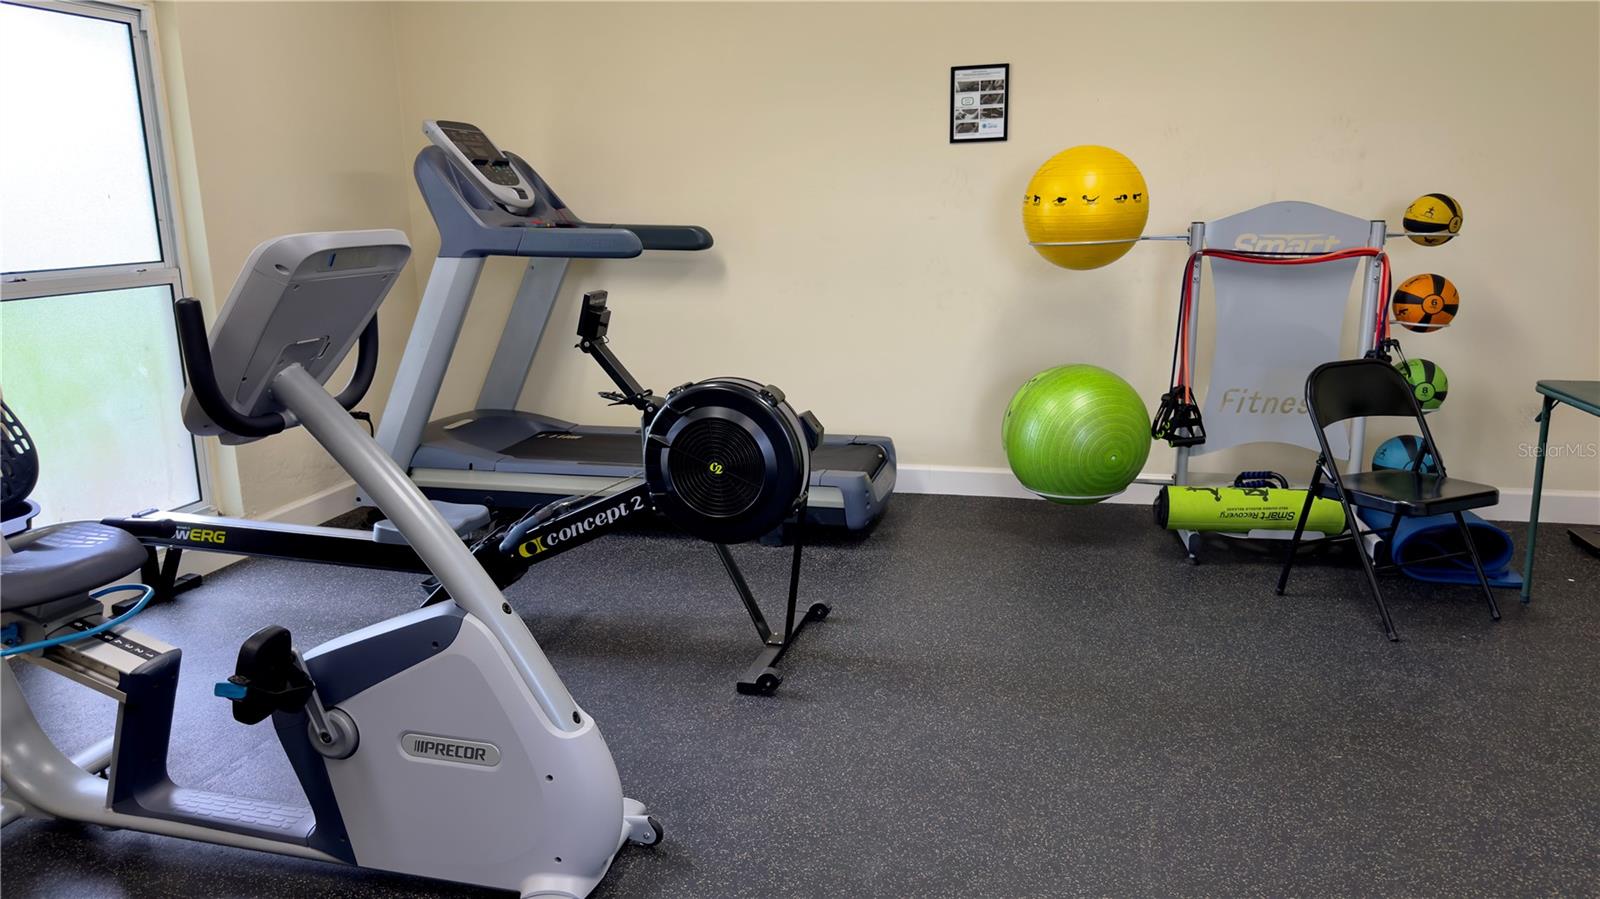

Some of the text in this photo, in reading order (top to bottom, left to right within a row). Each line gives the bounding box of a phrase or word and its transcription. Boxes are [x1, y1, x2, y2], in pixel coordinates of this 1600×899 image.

[1235, 232, 1341, 257] Smart
[1219, 388, 1308, 414] Fitnes
[709, 462, 724, 475] C2
[546, 495, 645, 547] concept 2
[1219, 511, 1296, 521] Smart Recovery
[423, 740, 487, 762] PRECOR
